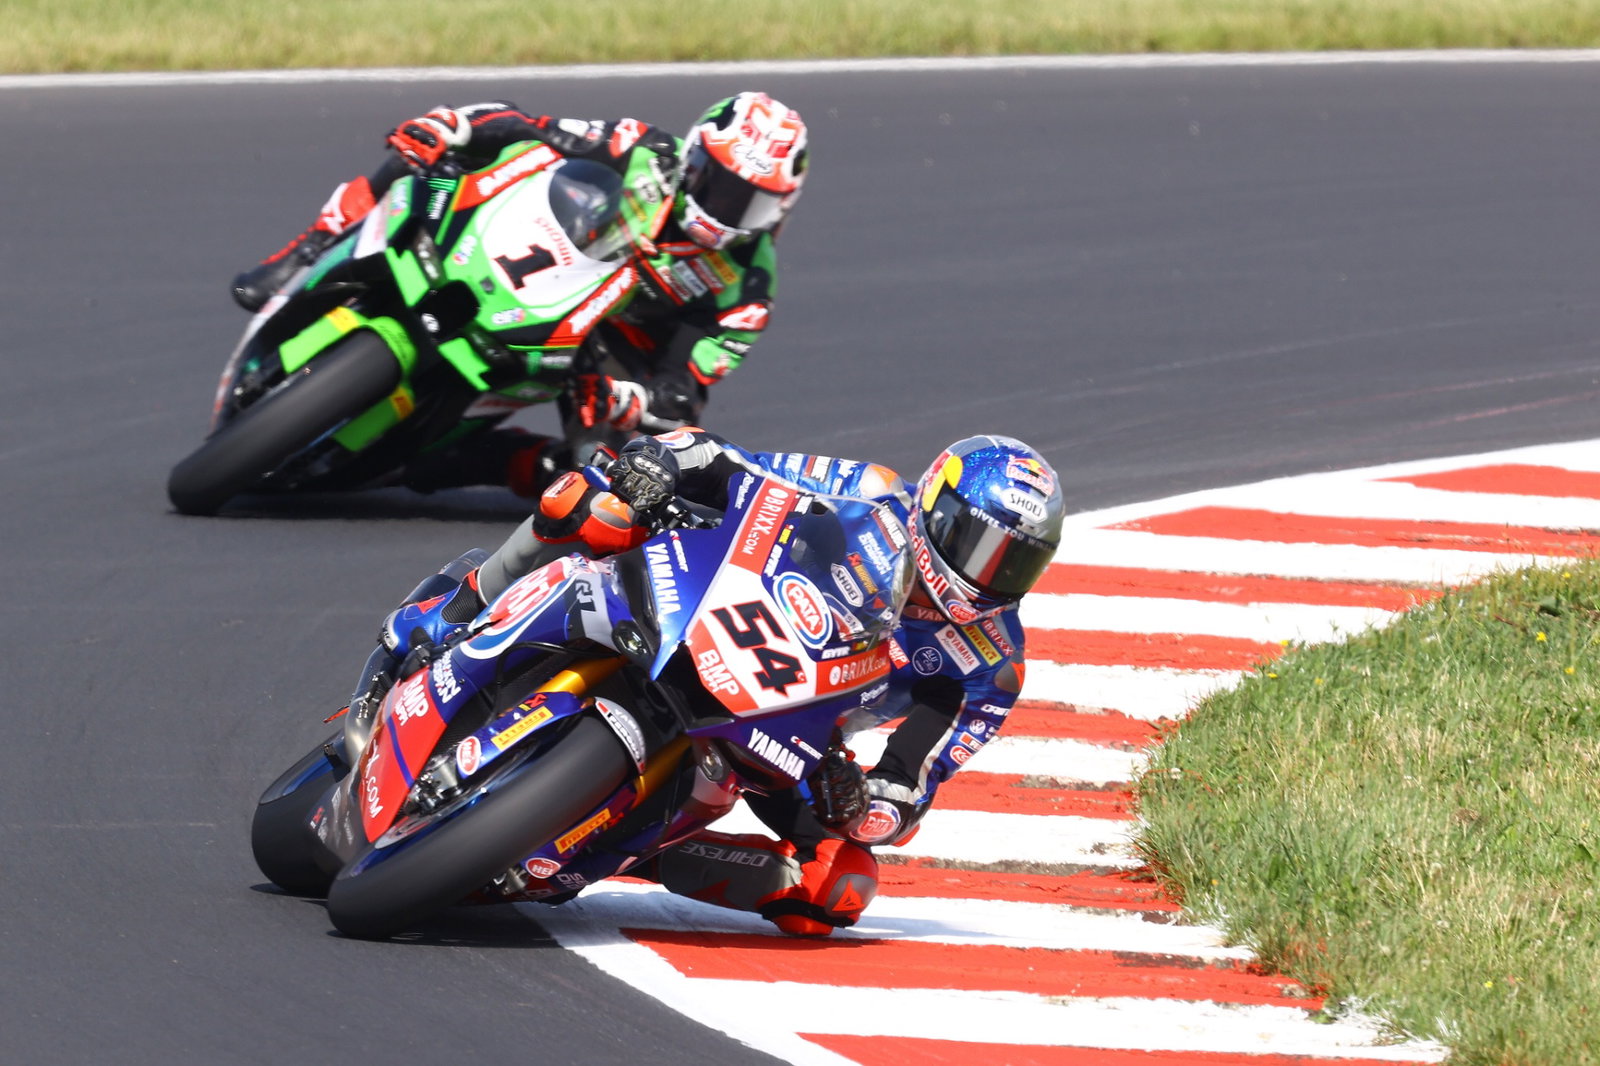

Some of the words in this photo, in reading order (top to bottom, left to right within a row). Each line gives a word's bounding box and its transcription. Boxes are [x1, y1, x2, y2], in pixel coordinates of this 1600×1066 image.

[494, 243, 558, 291] 1
[969, 506, 1000, 529] GIVES
[1004, 525, 1025, 542] YOU
[645, 541, 683, 615] YAMAHA
[836, 569, 859, 600] SHOEI
[916, 545, 950, 597] Bull
[787, 584, 822, 632] PATA
[709, 600, 807, 698] 54
[952, 636, 975, 667] YAMAHA
[965, 625, 997, 660] PIRELLI
[984, 621, 1014, 656] BRIXX
[697, 662, 721, 693] TAPPI
[698, 649, 740, 696] BMP
[747, 727, 806, 781] YAMAHA
[680, 841, 771, 868] DAINESE
